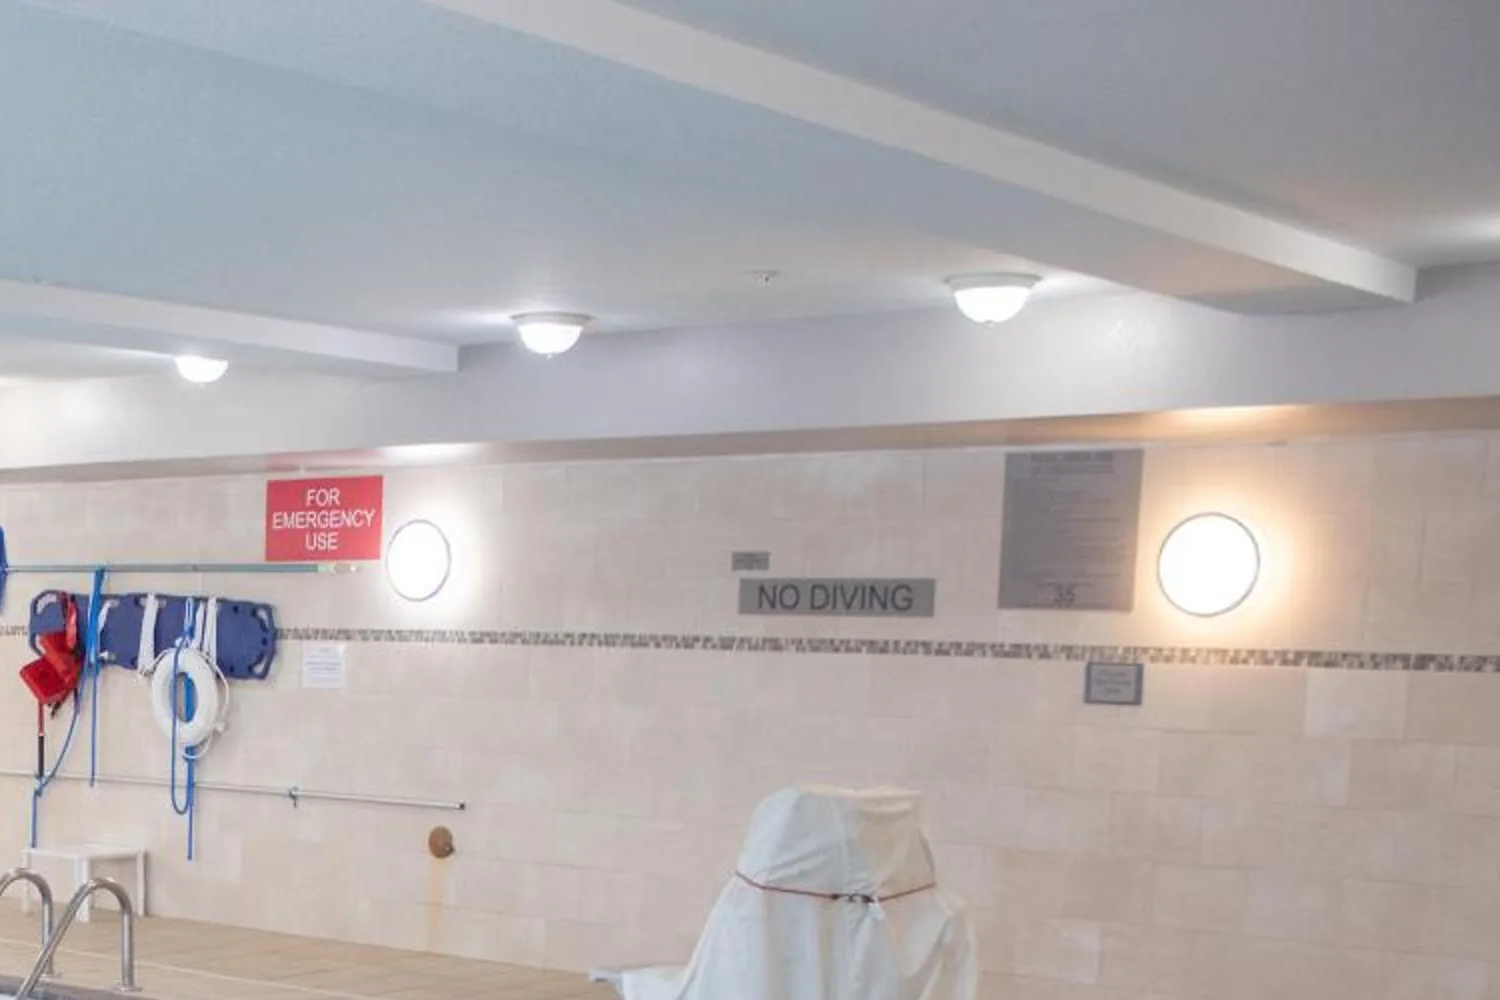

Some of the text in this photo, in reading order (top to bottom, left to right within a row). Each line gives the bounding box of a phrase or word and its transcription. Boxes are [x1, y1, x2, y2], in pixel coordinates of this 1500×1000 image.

[305, 487, 342, 506] FOR
[271, 509, 377, 529] EMERGENCY
[305, 532, 340, 551] USE
[757, 583, 915, 612] NO DIVING
